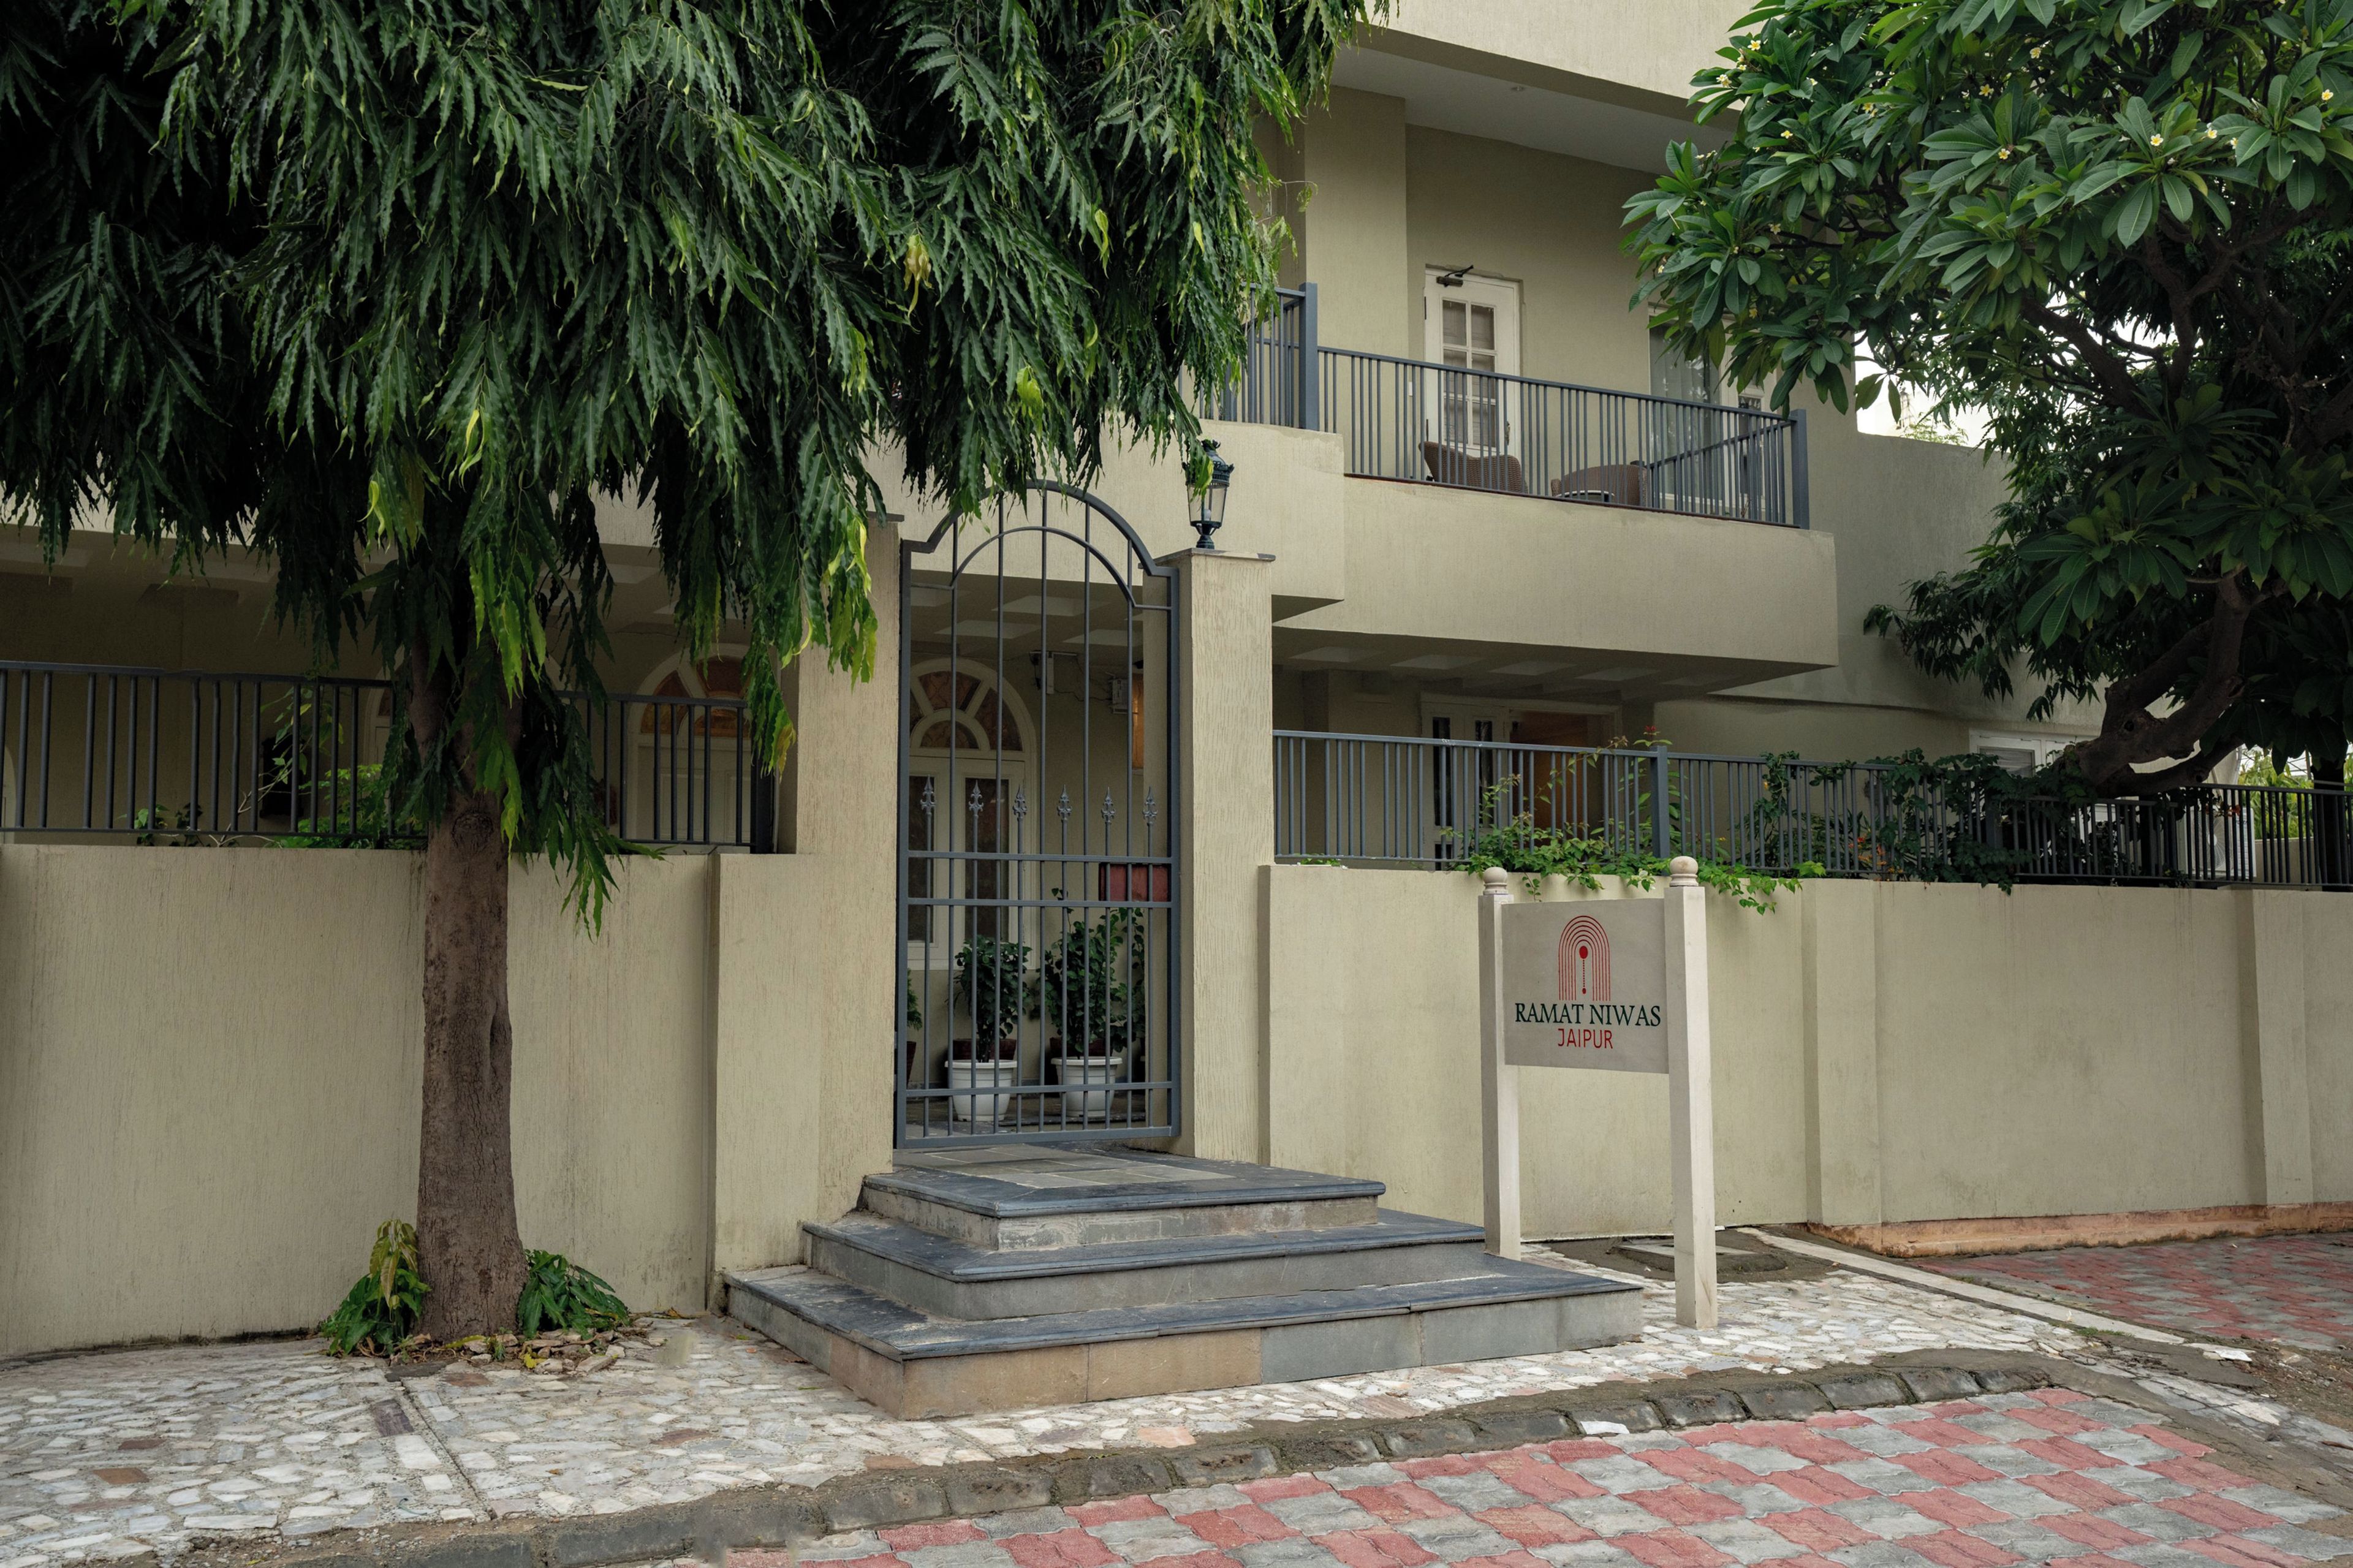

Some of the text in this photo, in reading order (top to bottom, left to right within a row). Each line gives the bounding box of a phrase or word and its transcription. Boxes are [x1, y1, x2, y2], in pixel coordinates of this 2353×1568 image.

[1515, 1002, 1661, 1026] RAMAT NIWAS
[1558, 1028, 1613, 1049] JAIPUR
